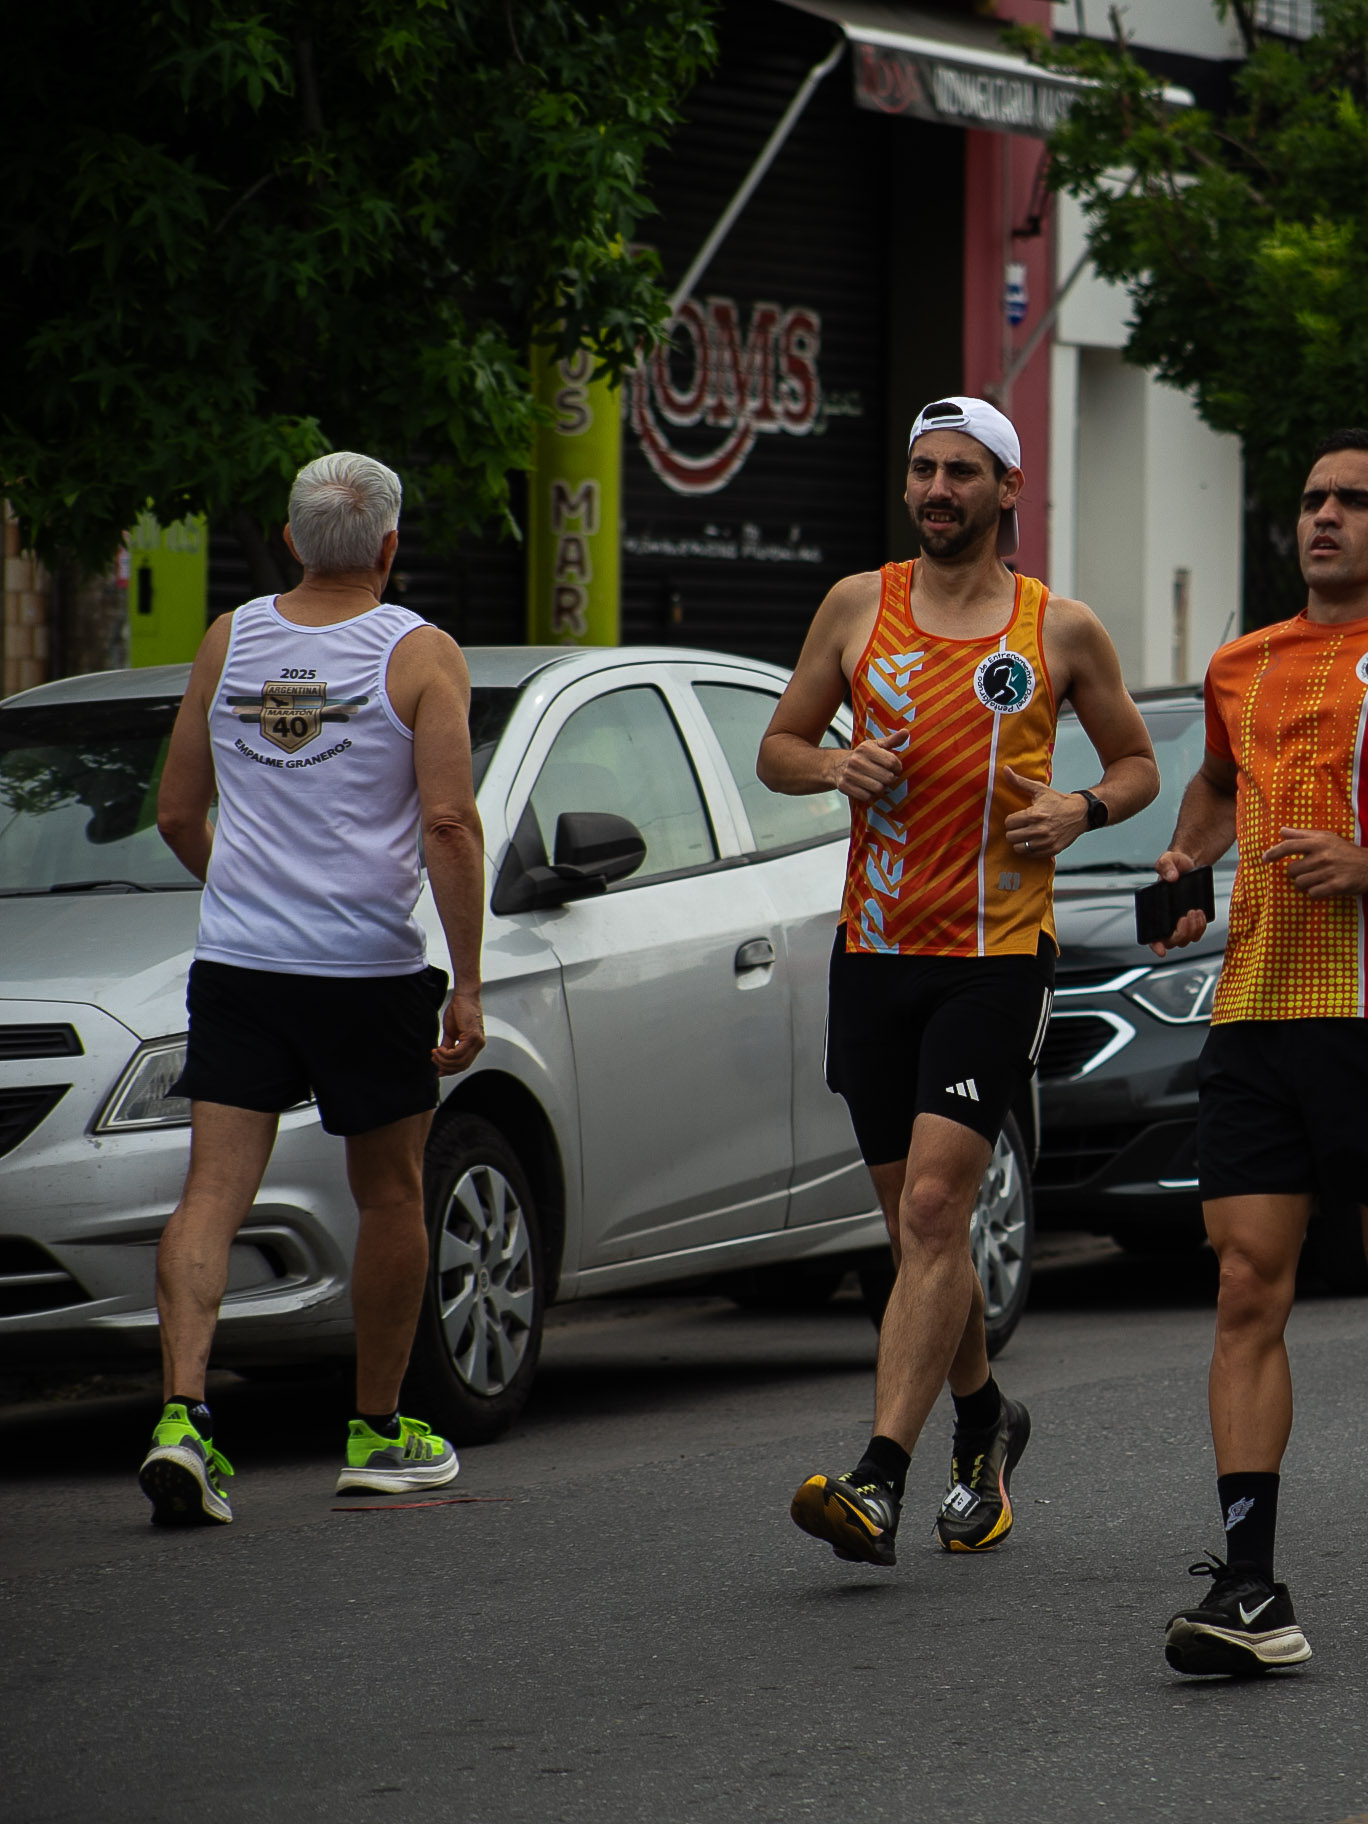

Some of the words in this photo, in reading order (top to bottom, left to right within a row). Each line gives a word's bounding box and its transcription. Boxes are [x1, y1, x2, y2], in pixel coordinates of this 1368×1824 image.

[550, 478, 600, 644] MAR
[280, 668, 317, 680] 2025
[268, 686, 318, 695] ARGENTINA
[272, 717, 308, 738] 40
[234, 738, 284, 768] EMPALME
[285, 738, 352, 768] GRANEROS
